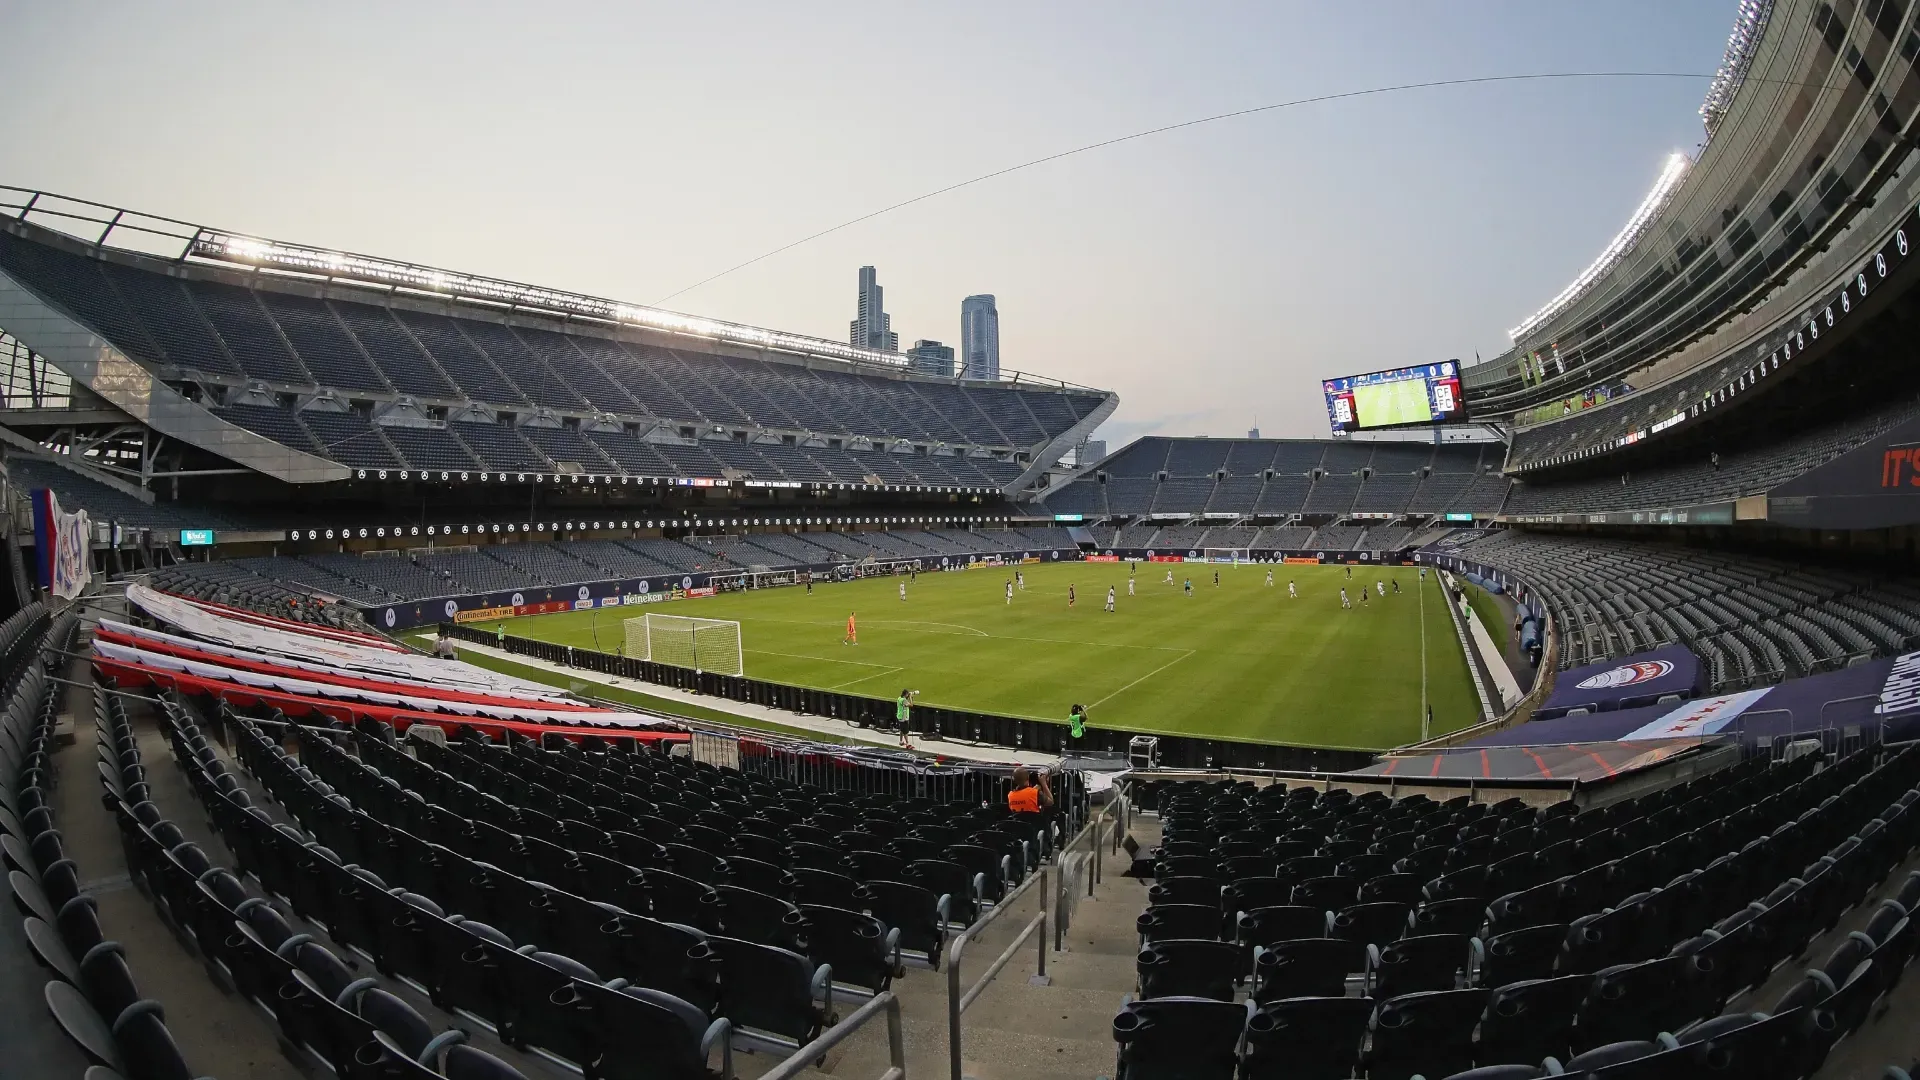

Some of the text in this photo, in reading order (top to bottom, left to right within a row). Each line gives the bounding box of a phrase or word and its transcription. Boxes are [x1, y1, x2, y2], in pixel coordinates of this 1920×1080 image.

[1430, 366, 1437, 376] 0
[1342, 380, 1349, 389] 2
[1436, 387, 1449, 398] CF
[1336, 400, 1347, 410] CF
[1439, 399, 1453, 409] FC
[1339, 411, 1350, 420] FC
[623, 593, 663, 605] Heineken
[457, 609, 492, 622] Continental
[499, 608, 513, 616] TIRE
